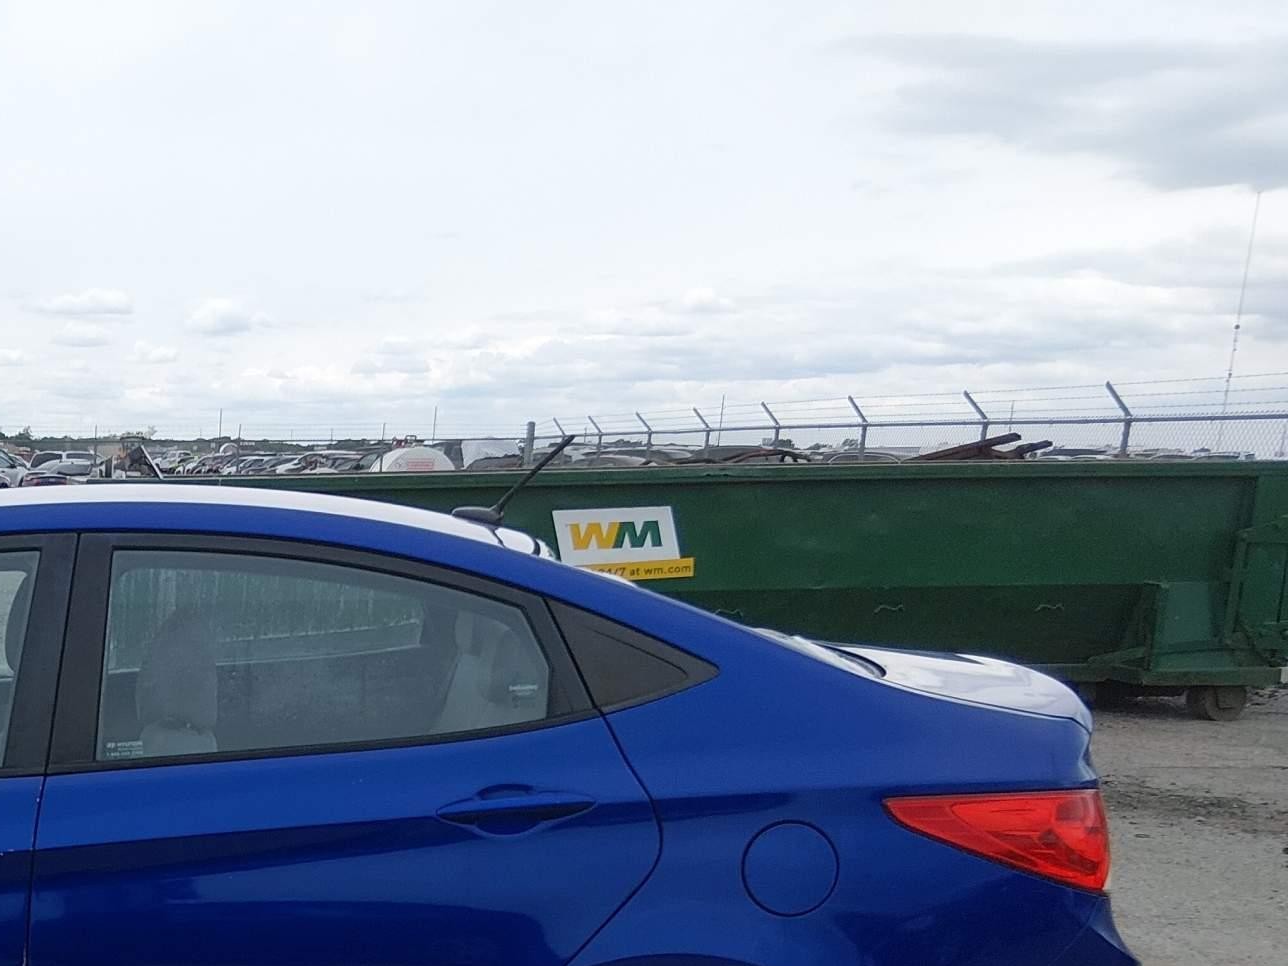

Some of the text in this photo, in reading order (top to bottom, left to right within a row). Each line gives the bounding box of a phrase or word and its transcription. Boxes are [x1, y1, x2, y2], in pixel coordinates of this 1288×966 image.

[569, 520, 663, 550] WM
[629, 568, 640, 577] at
[644, 565, 691, 576] wm.com
